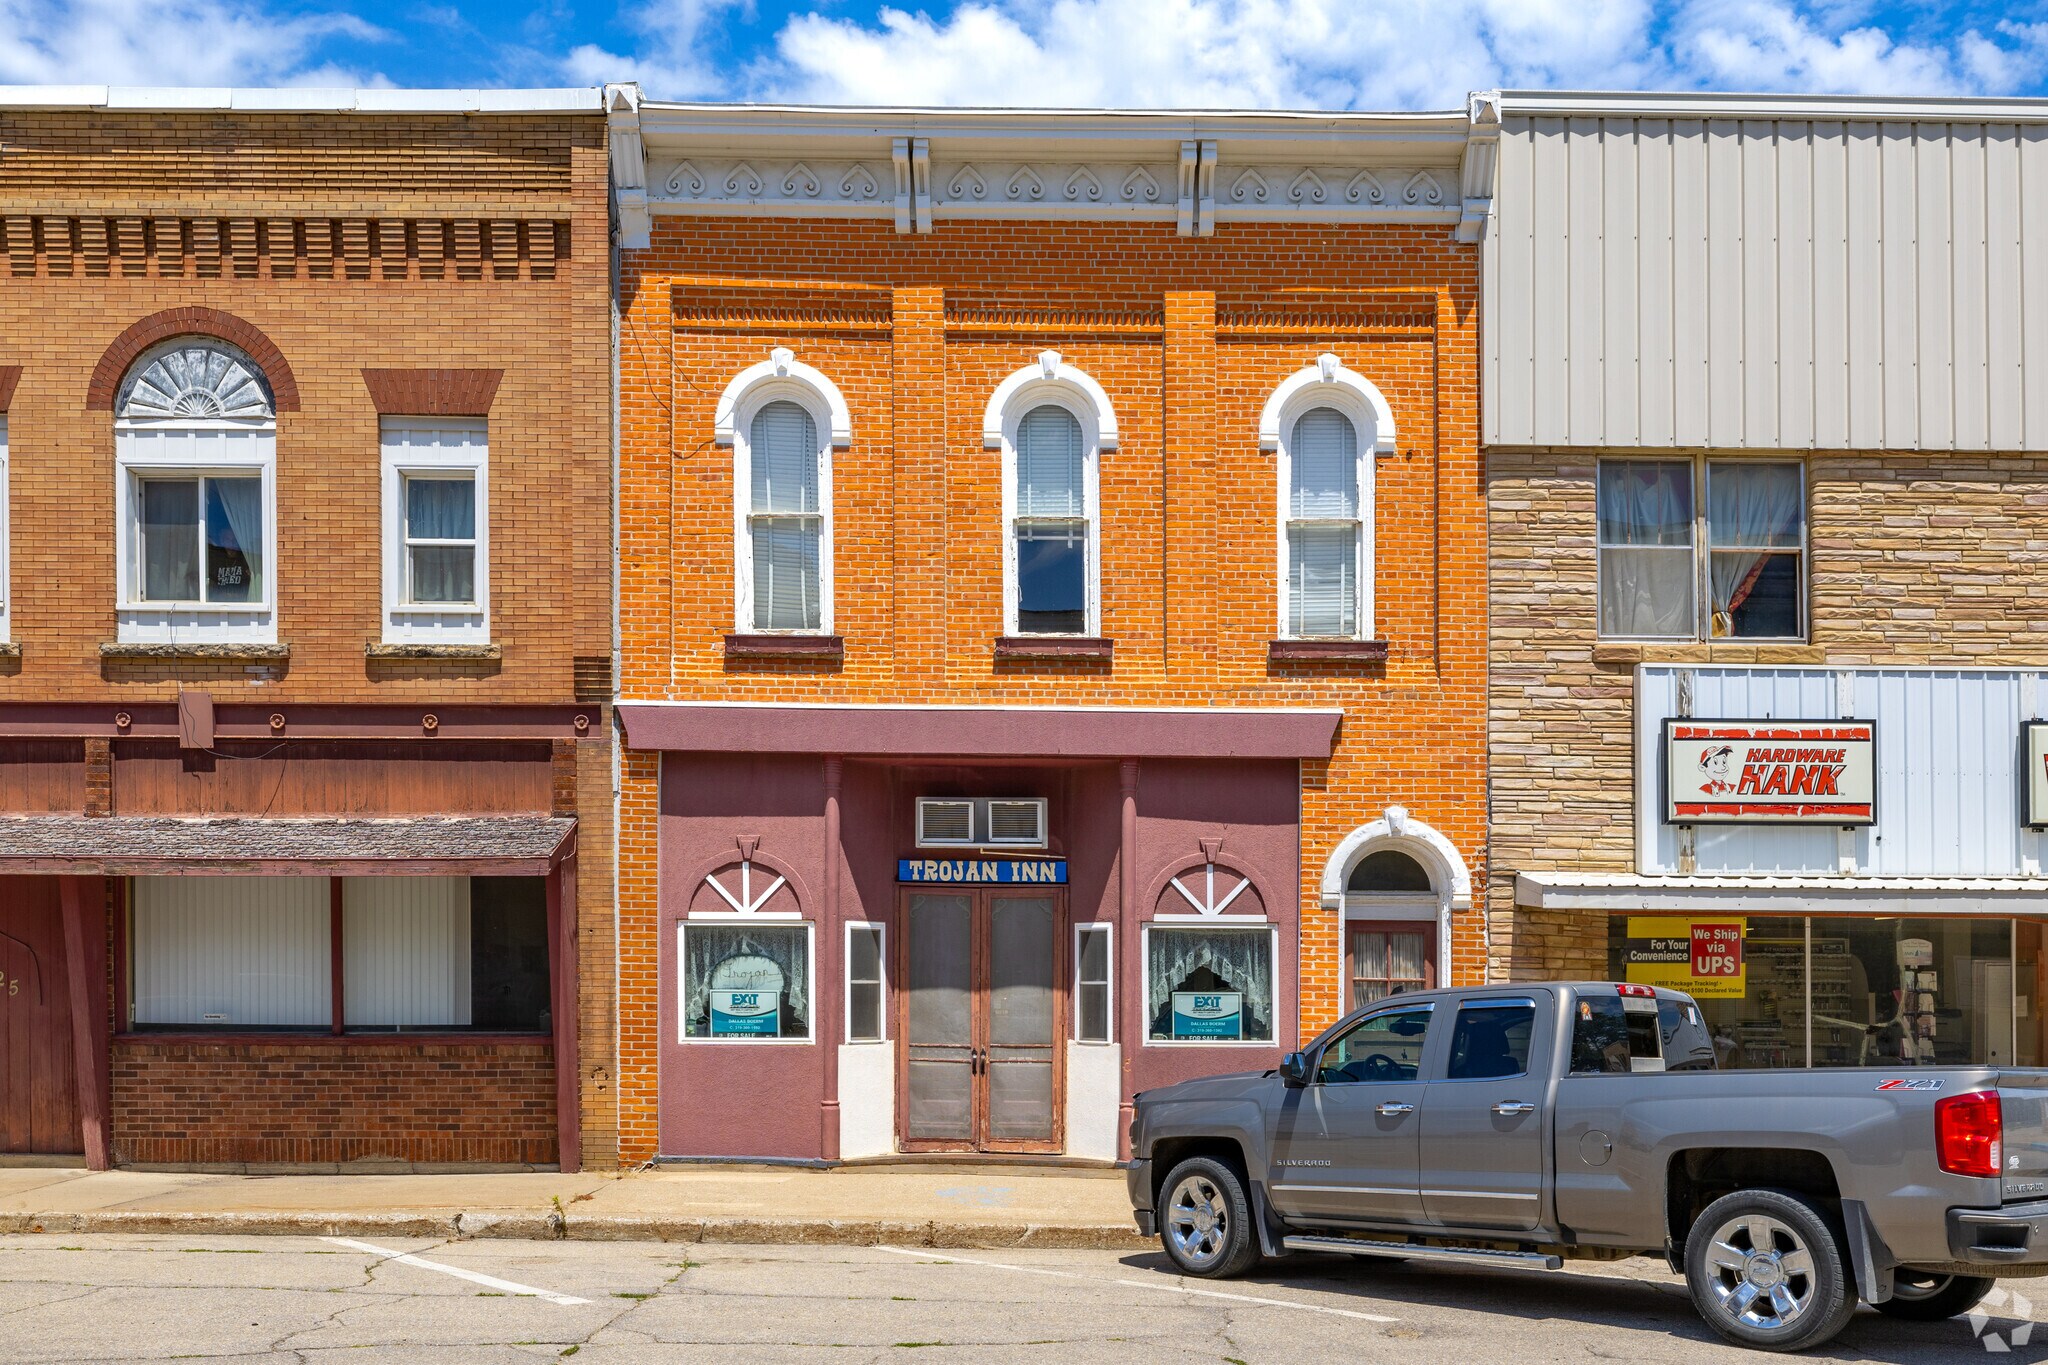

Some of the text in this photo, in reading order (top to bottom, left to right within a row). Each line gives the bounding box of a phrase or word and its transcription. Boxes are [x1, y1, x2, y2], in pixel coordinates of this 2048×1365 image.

[1745, 748, 1847, 763] HARDWARE
[1737, 764, 1847, 795] HANK
[909, 860, 1056, 882] TROJAN INN
[1693, 928, 1738, 942] We Ship
[1650, 940, 1688, 950] For Your
[1706, 941, 1726, 953] via
[1630, 950, 1688, 961] Convenience
[1697, 956, 1735, 974] UPS
[731, 993, 759, 1005] EXIT
[1194, 996, 1222, 1007] EXIT
[1873, 1079, 1947, 1091] Z71
[1276, 1159, 1331, 1167] SILVERADO
[2006, 1182, 2045, 1195] SILVERADO
